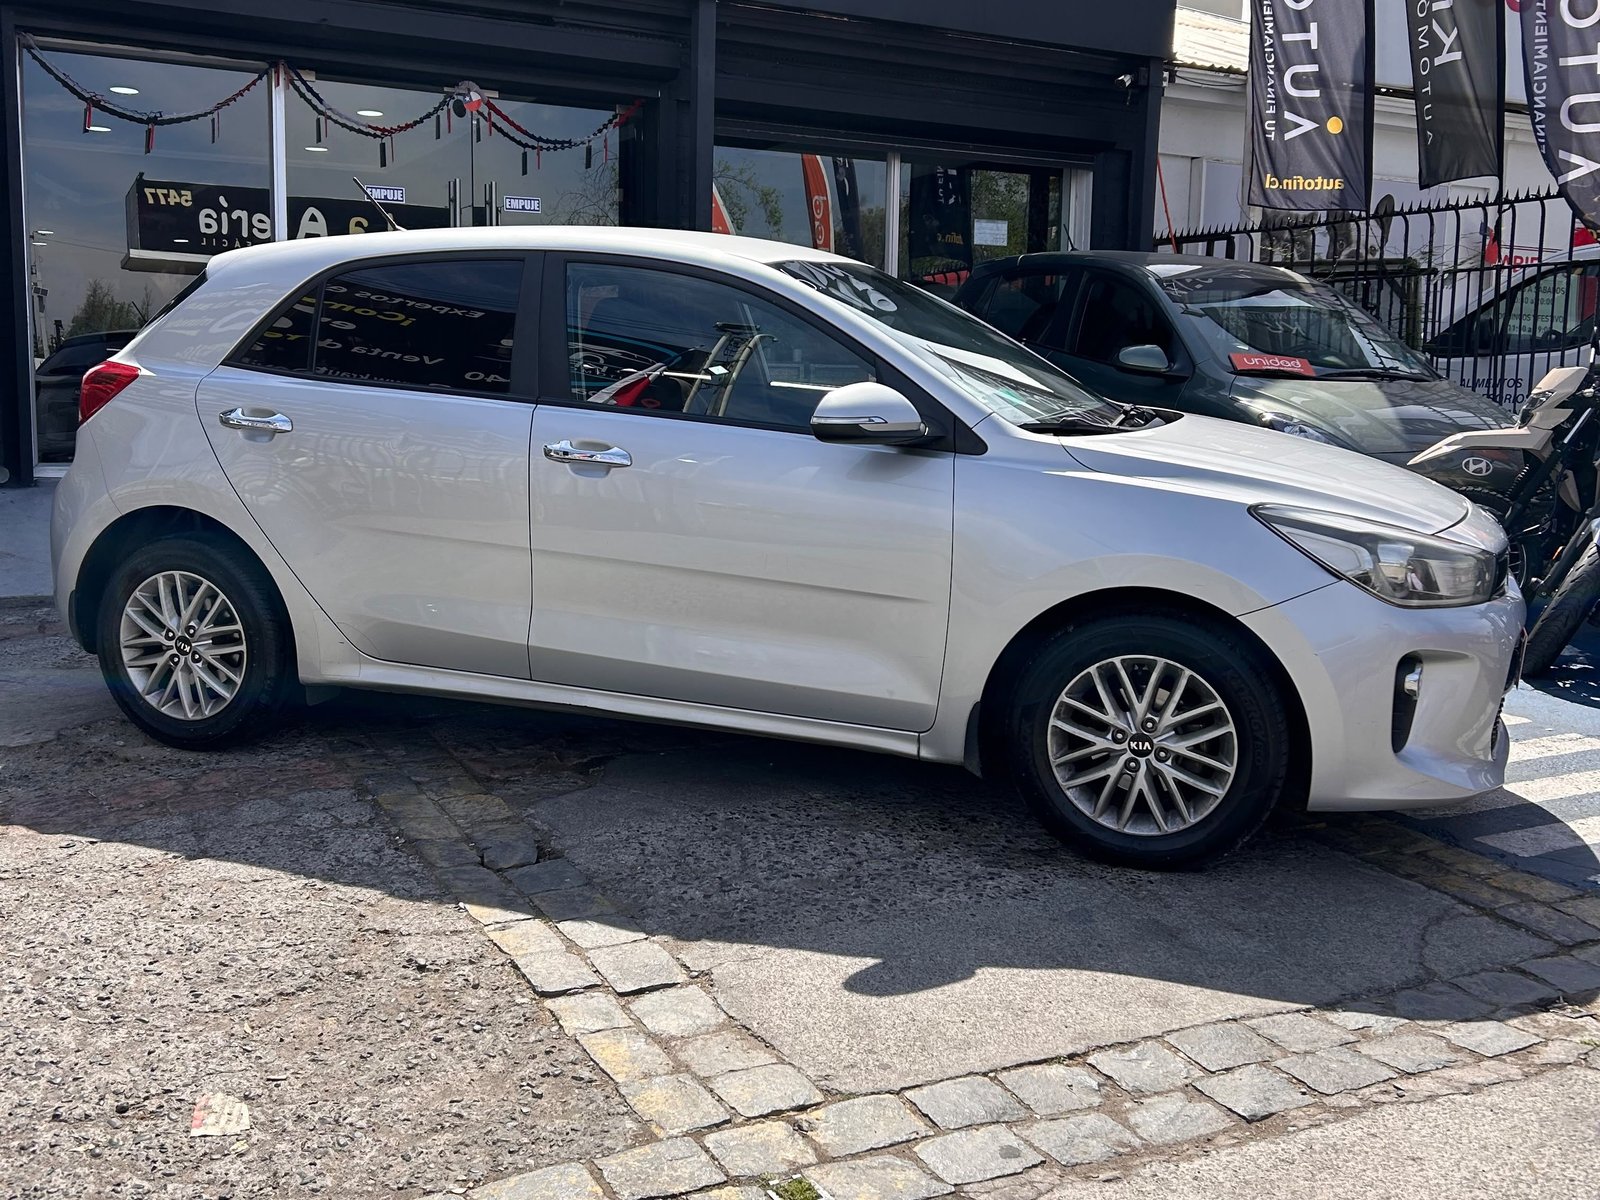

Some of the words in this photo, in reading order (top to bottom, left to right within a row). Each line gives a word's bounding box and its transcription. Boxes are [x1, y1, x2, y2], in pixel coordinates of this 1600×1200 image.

[367, 187, 404, 202] EMPUJE
[505, 198, 540, 211] EMPUJE
[1243, 356, 1302, 368] unidad
[1129, 741, 1152, 751] KIA
